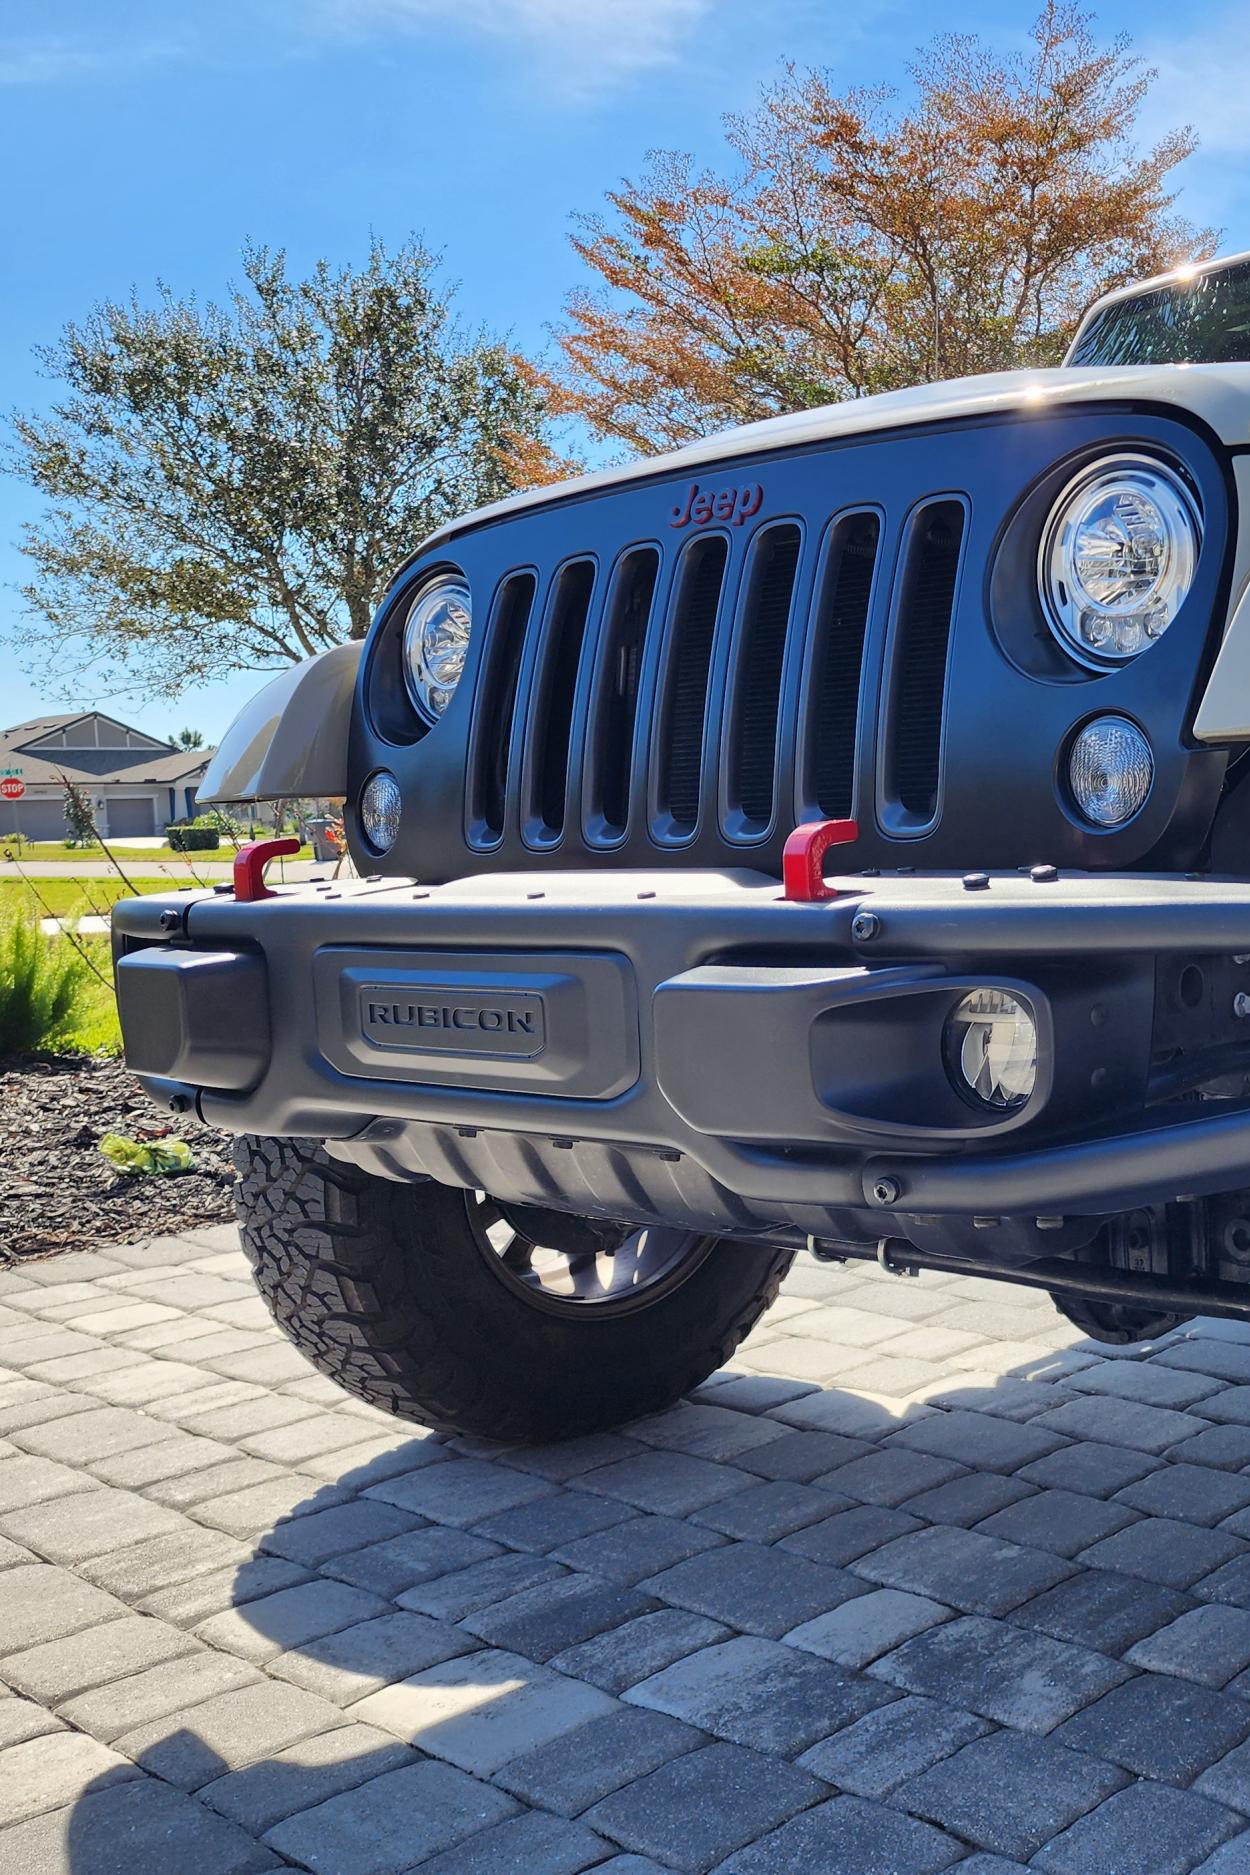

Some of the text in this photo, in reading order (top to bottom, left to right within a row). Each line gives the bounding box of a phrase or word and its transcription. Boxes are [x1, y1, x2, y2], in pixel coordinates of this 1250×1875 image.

[668, 482, 764, 529] Jeep
[1, 784, 24, 793] STOP
[368, 1002, 536, 1033] RUBICON
